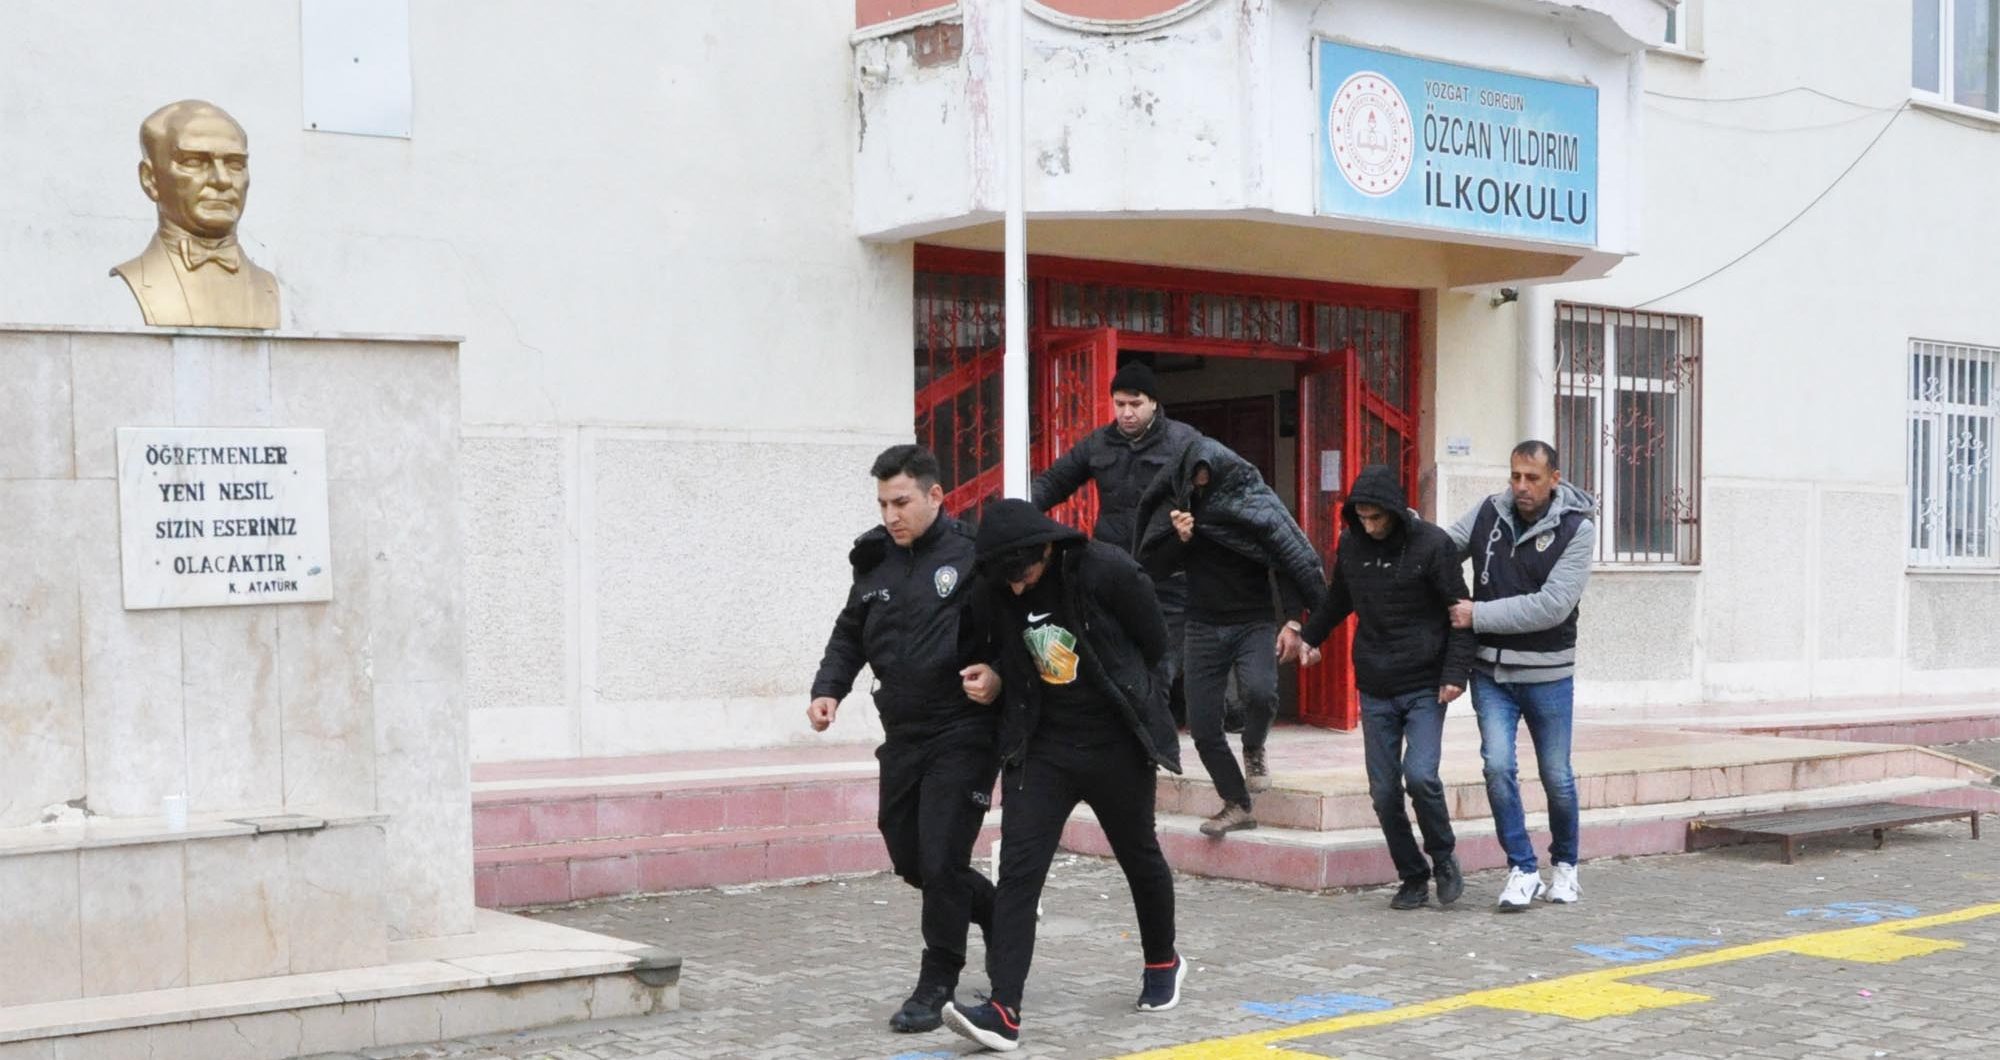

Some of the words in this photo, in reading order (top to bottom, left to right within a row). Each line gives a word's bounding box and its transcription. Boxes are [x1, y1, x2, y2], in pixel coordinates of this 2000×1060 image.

[1425, 81, 1469, 102] YOZGAT
[1480, 89, 1524, 112] SORGUN
[1424, 103, 1492, 160] ÖZCAN
[1499, 125, 1579, 173] YILDIRIM
[1425, 160, 1588, 226] İLKOKULU
[146, 444, 288, 465] ÖĞRETMENLER
[159, 480, 205, 502] YENİ
[219, 480, 274, 501] NESİL
[156, 518, 205, 539] SİZİN
[213, 515, 297, 537] ESERİNİZ
[174, 554, 286, 574] OLACAKTIR
[248, 577, 298, 592] ATATÜRK
